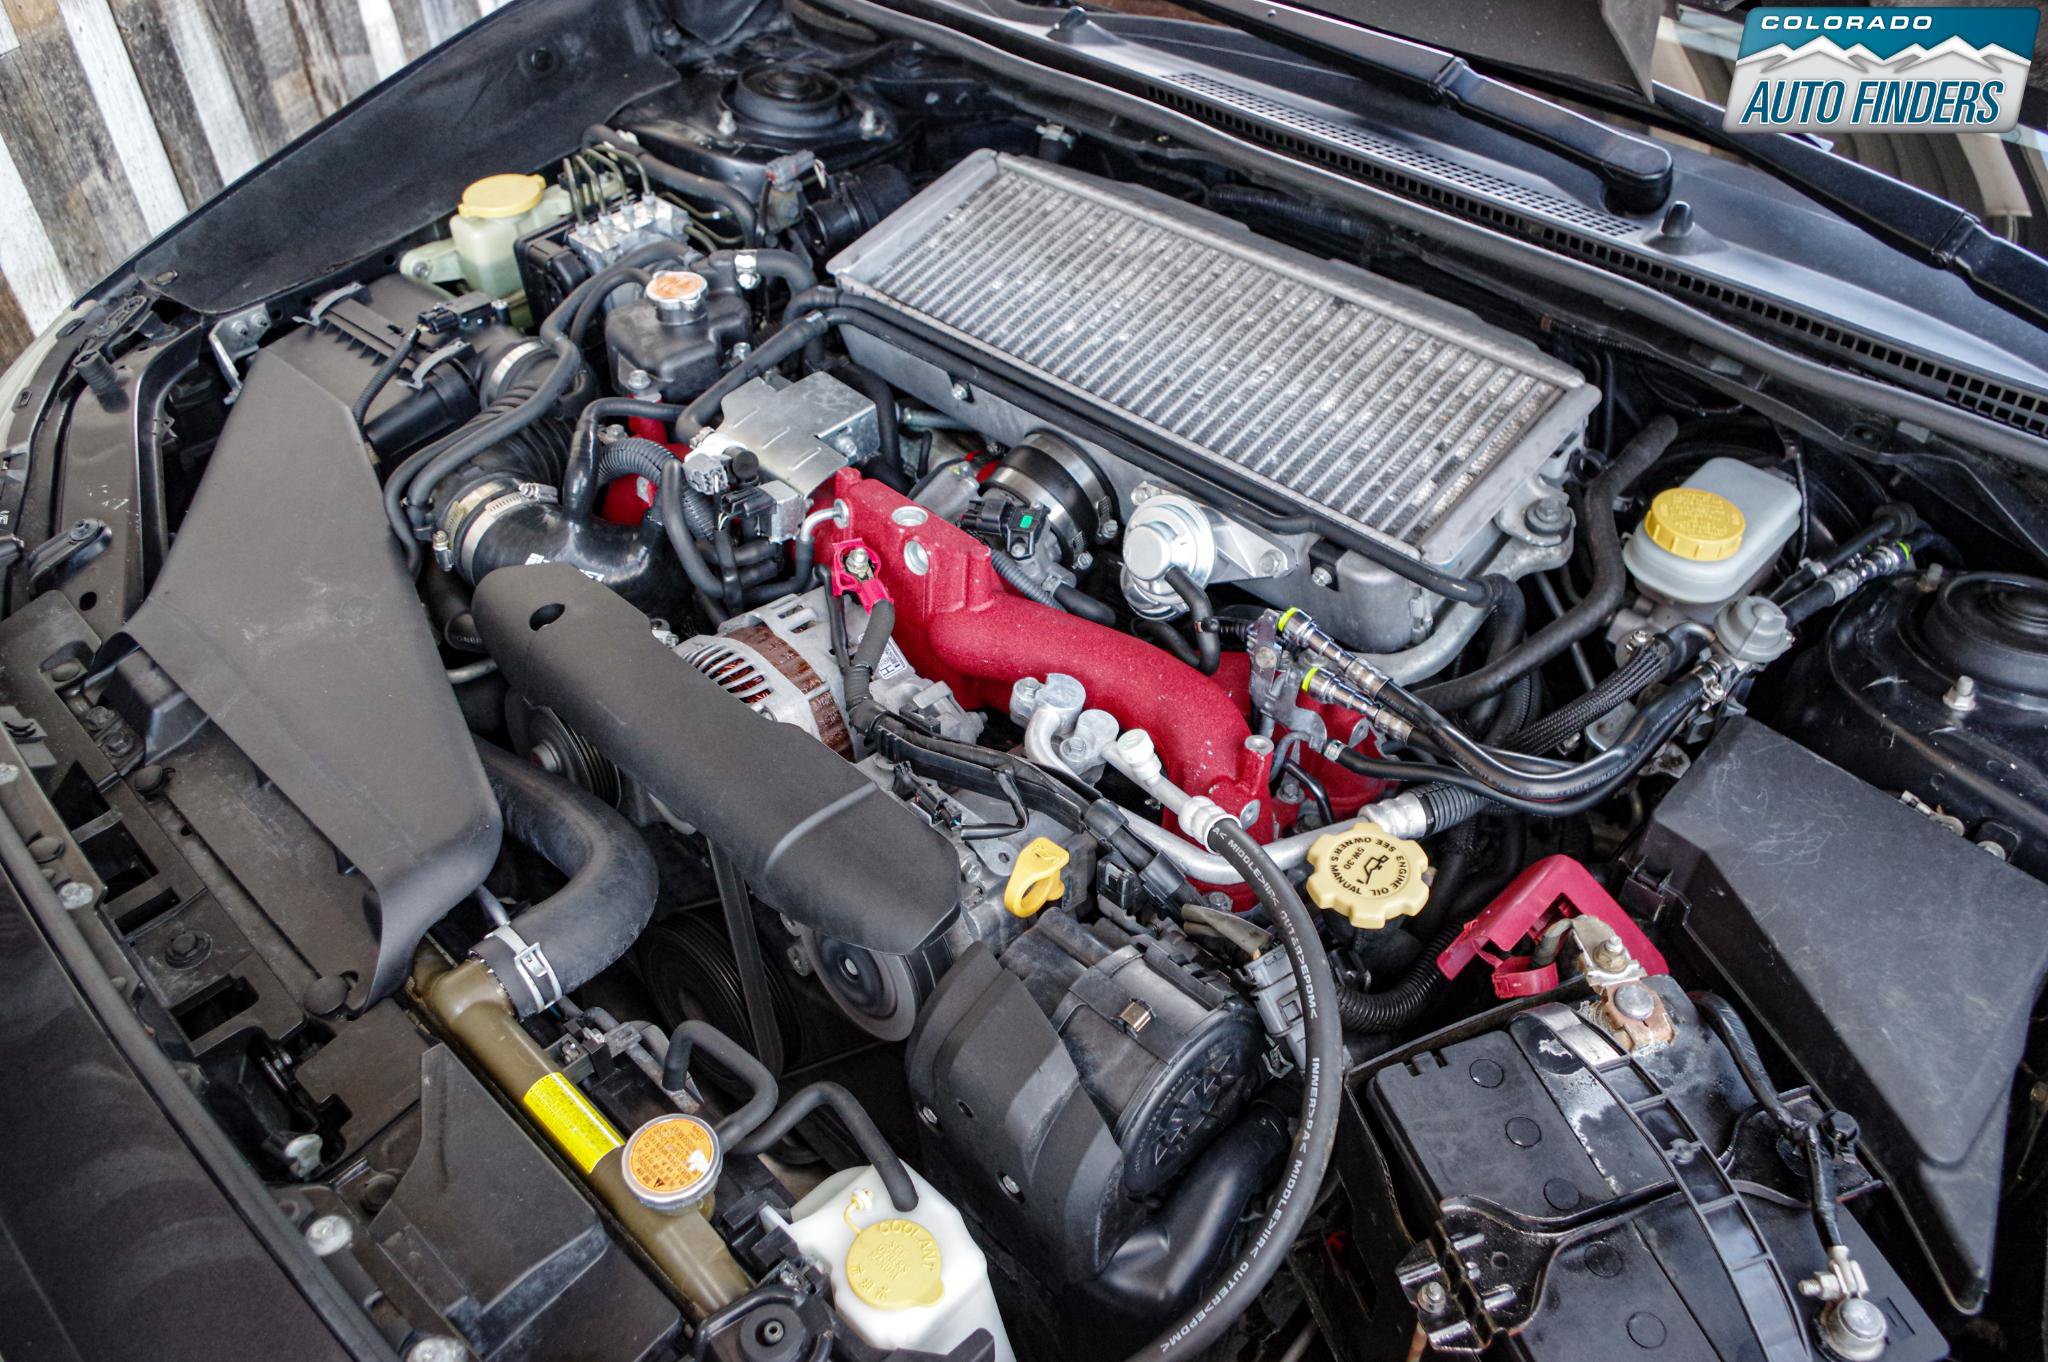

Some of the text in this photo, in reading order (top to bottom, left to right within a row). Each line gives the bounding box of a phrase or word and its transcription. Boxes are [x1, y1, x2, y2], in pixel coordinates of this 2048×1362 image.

[1376, 838, 1397, 853] SEE
[1330, 864, 1363, 895] MANUAL
[1370, 855, 1408, 896] ENGINE OIL
[878, 1219, 937, 1271] COOLANT
